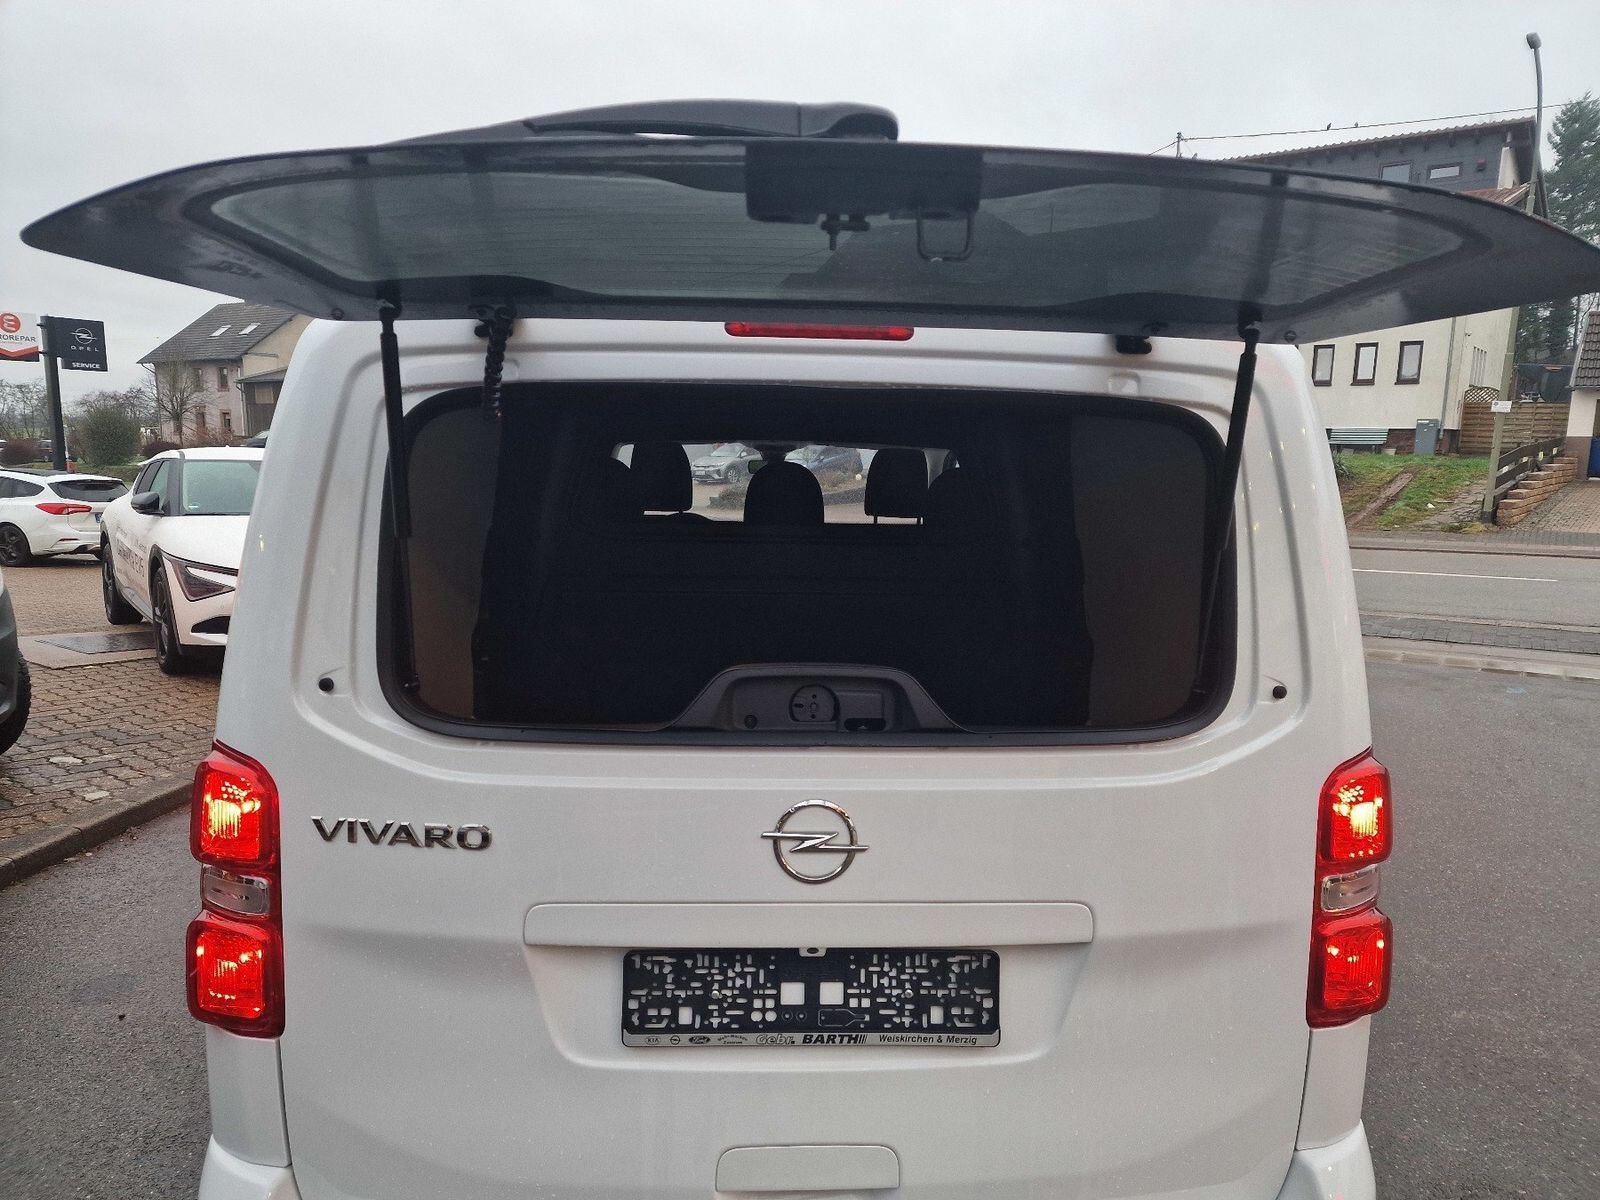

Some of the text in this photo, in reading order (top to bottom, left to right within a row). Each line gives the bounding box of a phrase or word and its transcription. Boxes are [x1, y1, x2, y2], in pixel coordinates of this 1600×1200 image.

[310, 815, 493, 851] VIVARO
[756, 1033, 796, 1046] Gebr.
[879, 1034, 935, 1043] Weiskirchen
[936, 1035, 943, 1043] &
[946, 1035, 978, 1046] Merzig
